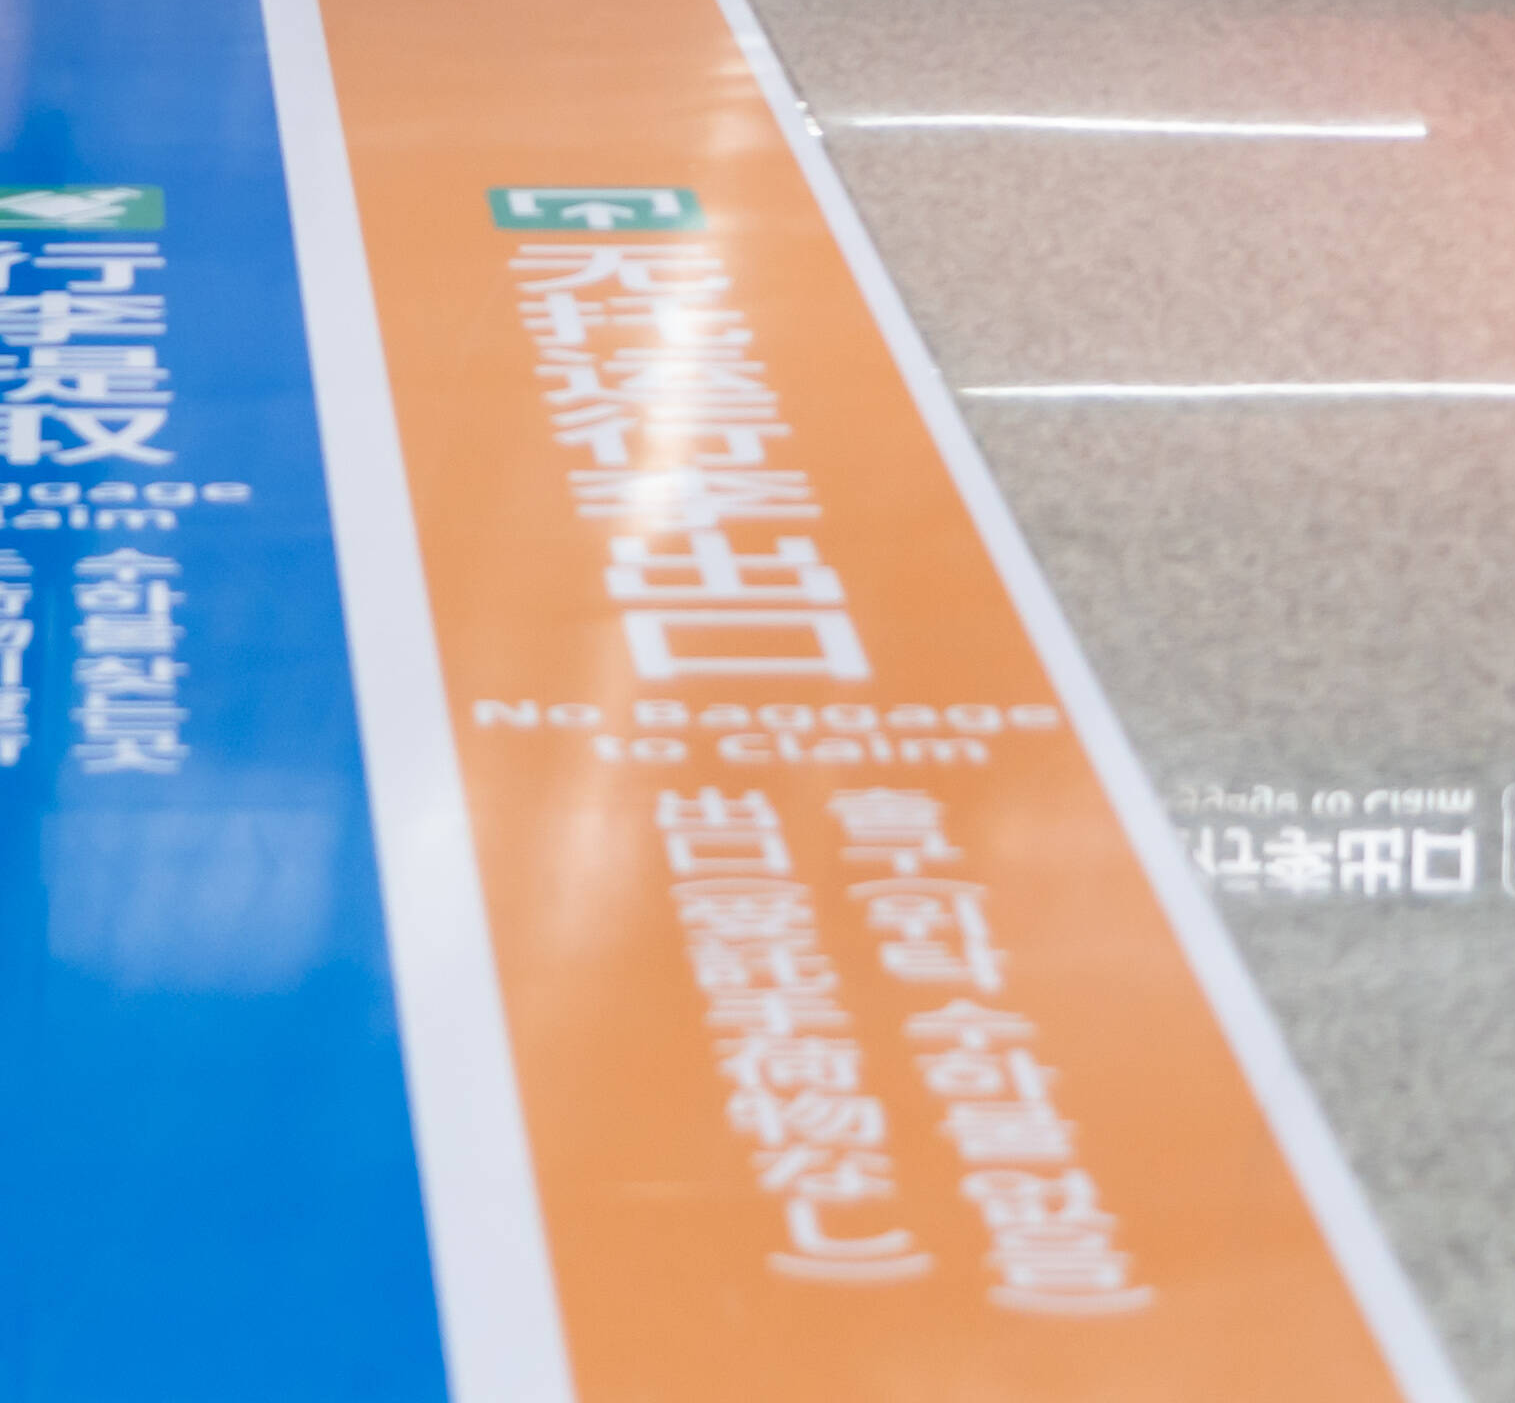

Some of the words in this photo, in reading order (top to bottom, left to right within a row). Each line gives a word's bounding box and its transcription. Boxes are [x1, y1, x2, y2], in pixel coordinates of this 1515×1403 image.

[473, 698, 602, 731] No
[634, 698, 1062, 735] Baggage
[593, 733, 689, 763] to
[718, 733, 990, 763] Claim
